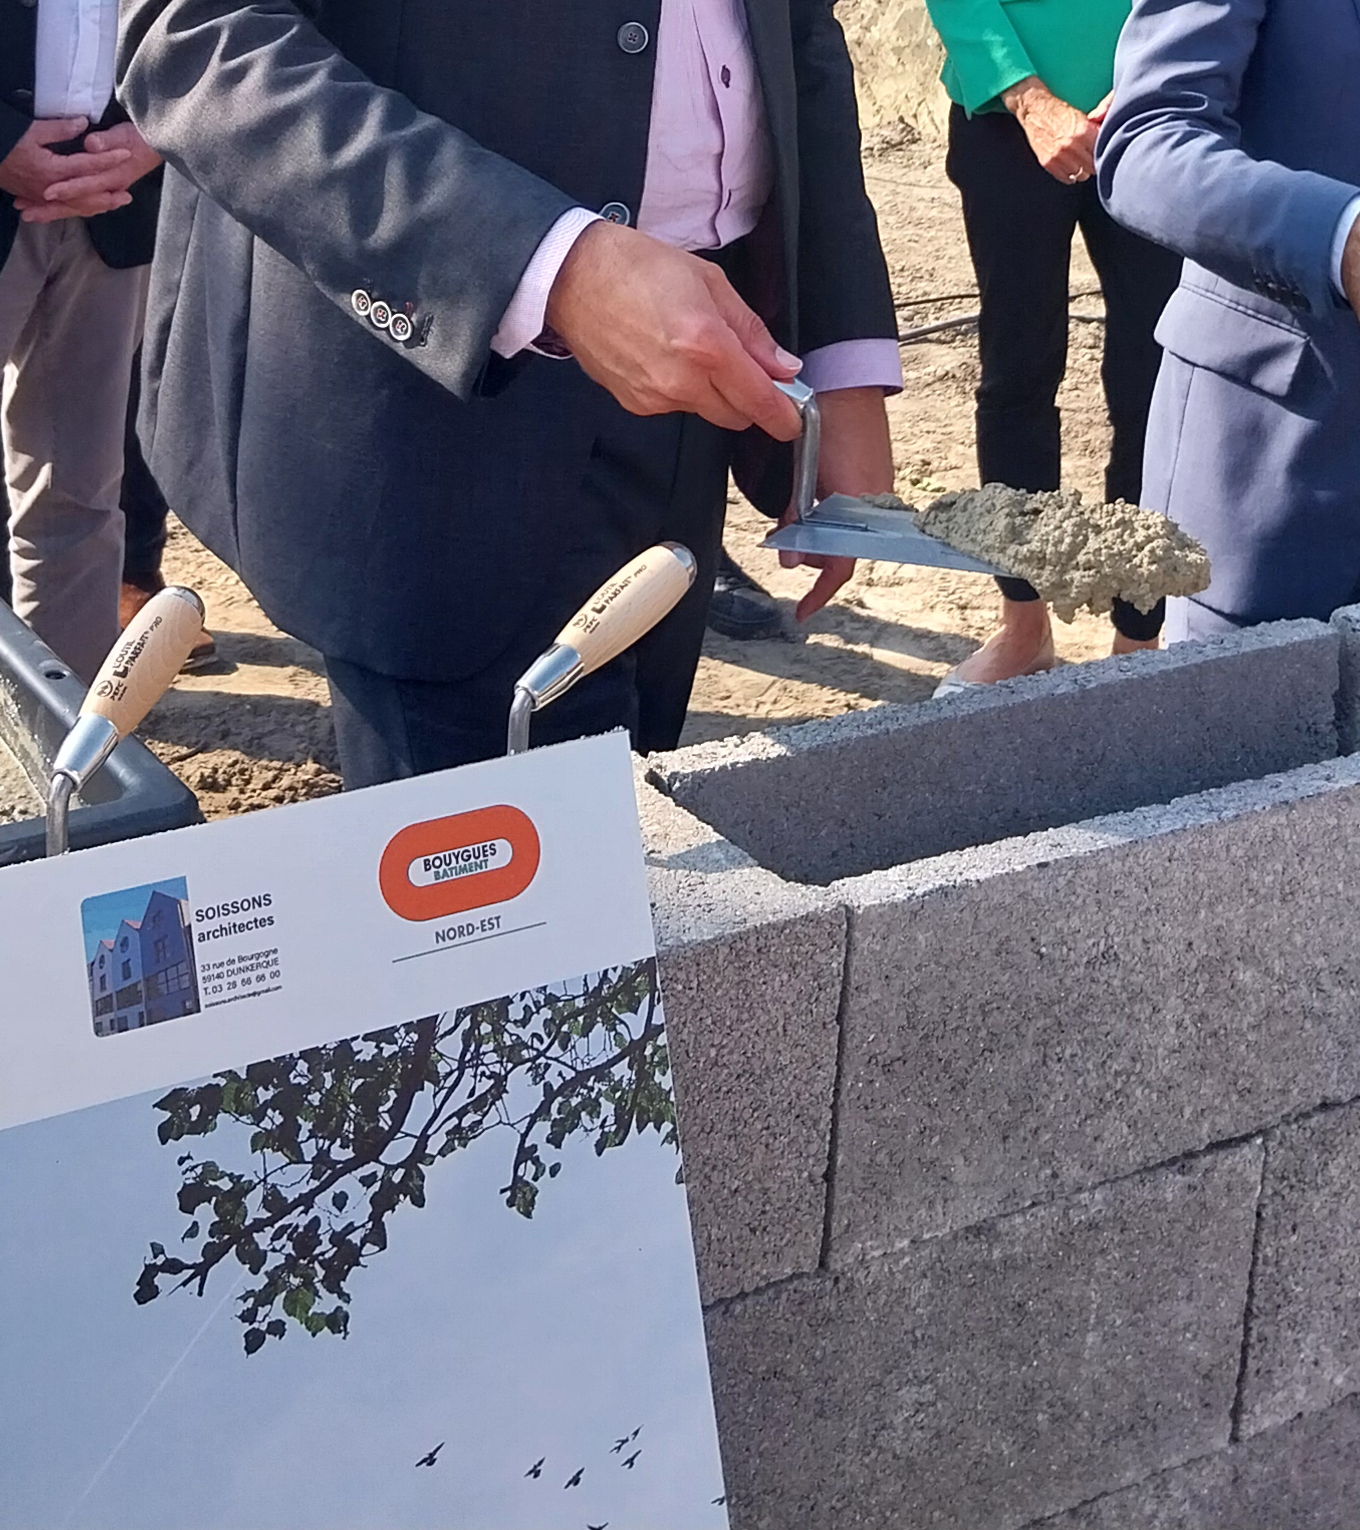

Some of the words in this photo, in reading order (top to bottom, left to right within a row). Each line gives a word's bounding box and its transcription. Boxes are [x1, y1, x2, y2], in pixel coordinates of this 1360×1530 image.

[423, 842, 497, 872] BOUYGUES
[433, 858, 489, 881] BATIMENT
[194, 893, 273, 923] SOISSONS
[197, 914, 275, 943] architectes
[434, 915, 501, 944] NORD-EST
[202, 971, 225, 985] 59140
[226, 957, 280, 977] DUNKERQUE
[212, 961, 225, 970] rue
[226, 957, 236, 967] de
[237, 948, 279, 964] Bourgogne
[269, 969, 281, 980] 00
